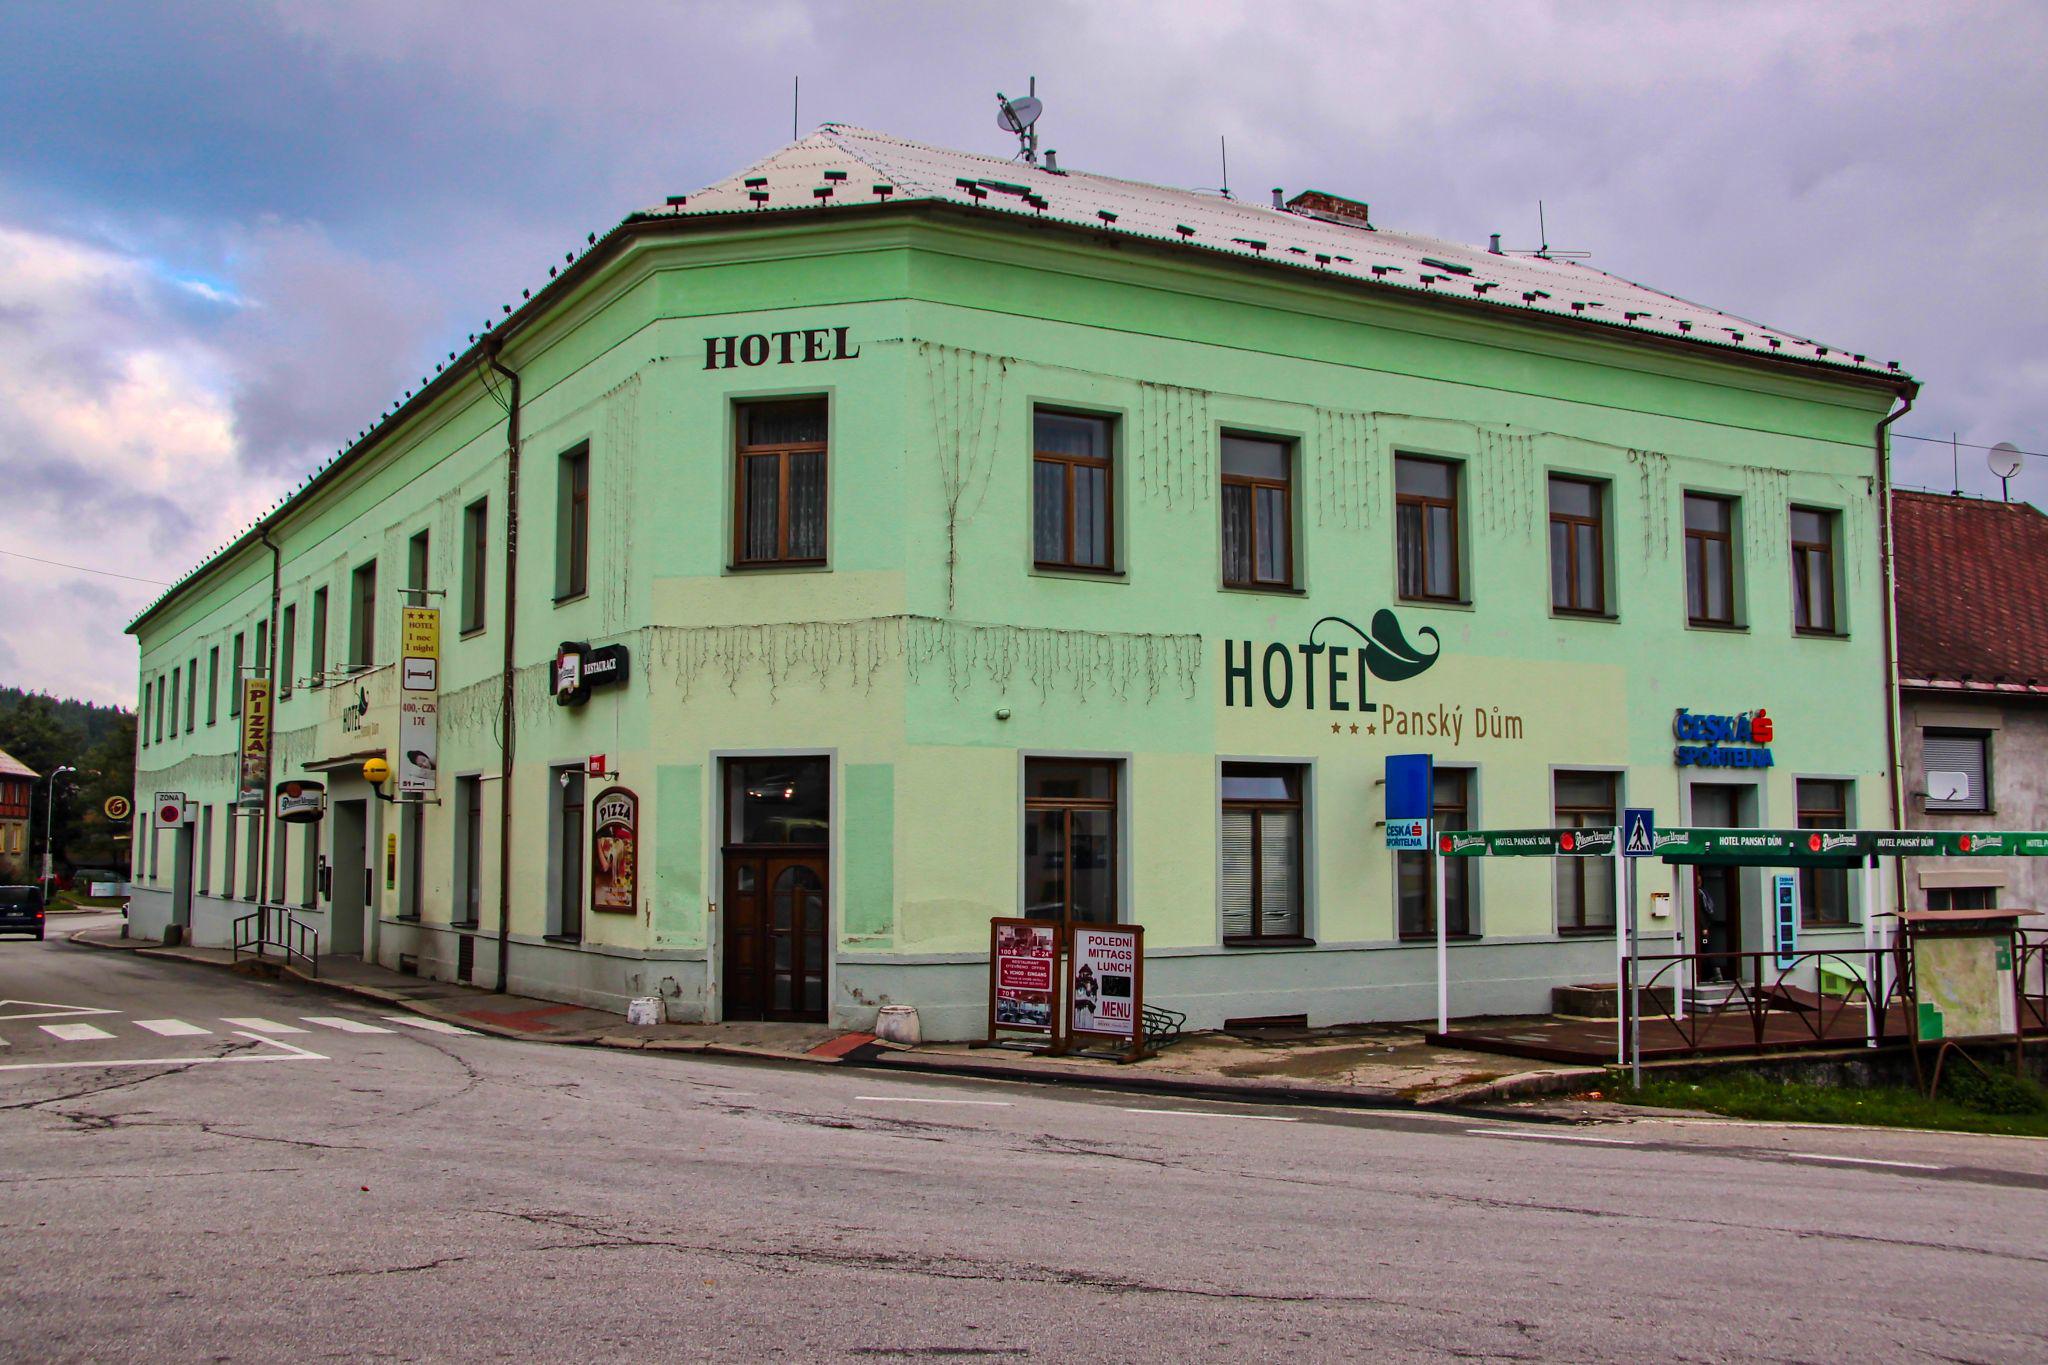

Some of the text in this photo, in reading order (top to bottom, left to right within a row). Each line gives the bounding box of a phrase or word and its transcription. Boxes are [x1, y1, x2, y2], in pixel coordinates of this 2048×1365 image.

[702, 326, 861, 371] HOTEL
[409, 622, 434, 630] HOTEL
[416, 634, 431, 642] noc
[413, 643, 434, 653] night
[584, 657, 617, 676] RESTAURACE
[1224, 638, 1378, 713] HOTEL
[421, 703, 436, 713] CZK
[247, 689, 266, 752] PIZZA
[1382, 703, 1524, 746] Panský Dům
[1673, 707, 1753, 743] ČESKÁ
[1674, 742, 1775, 768] SPOŘITELNA
[159, 794, 180, 802] ZONA
[599, 803, 631, 822] PIZZA
[1386, 822, 1412, 837] ČESKÁ
[1495, 835, 1551, 846] HOTEL PANSKÝ DŮM
[1719, 835, 1782, 846] HOTEL PANSKÝ DŮM
[1877, 836, 1934, 847] HOTEL PANSKÝ DŮM
[1088, 935, 1133, 949] POLEDNÍ
[1088, 948, 1132, 960] MITTAGS
[1097, 961, 1132, 973] LUNCH
[1102, 1001, 1131, 1019] MENU
